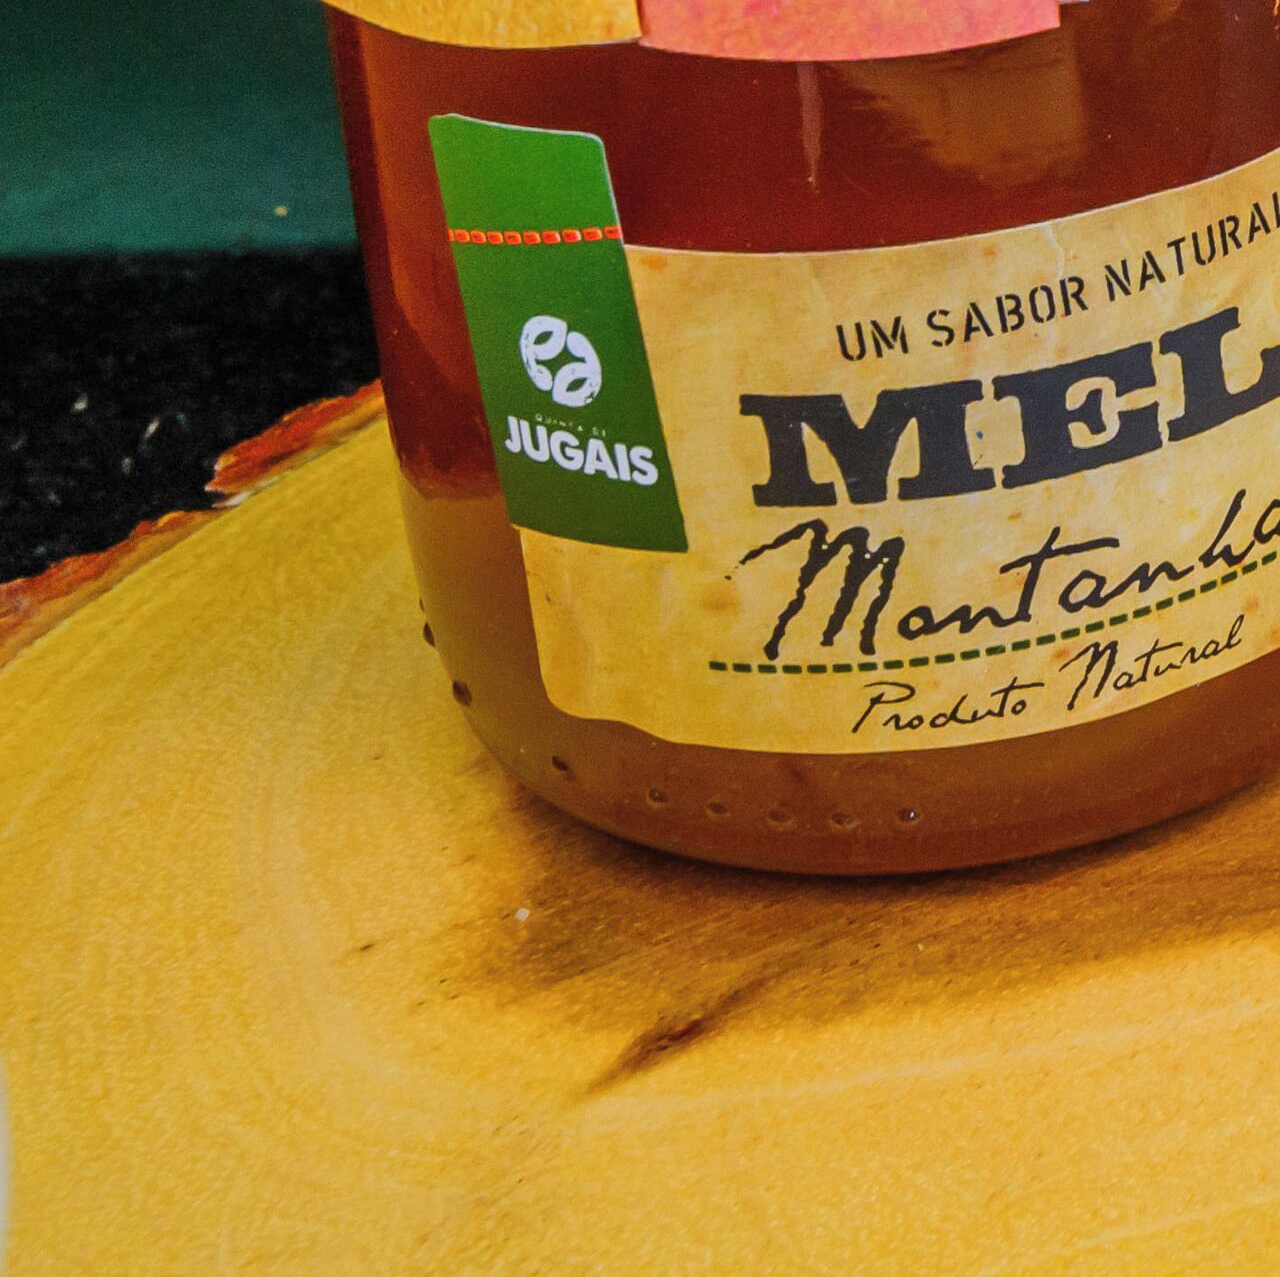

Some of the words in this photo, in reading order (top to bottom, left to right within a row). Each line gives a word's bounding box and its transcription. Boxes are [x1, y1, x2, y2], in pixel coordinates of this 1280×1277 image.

[836, 316, 909, 363] UM
[926, 275, 1090, 348] SABOR
[504, 415, 659, 487] JUGAIS
[851, 681, 1045, 734] Produto
[1059, 613, 1245, 711] Natural
